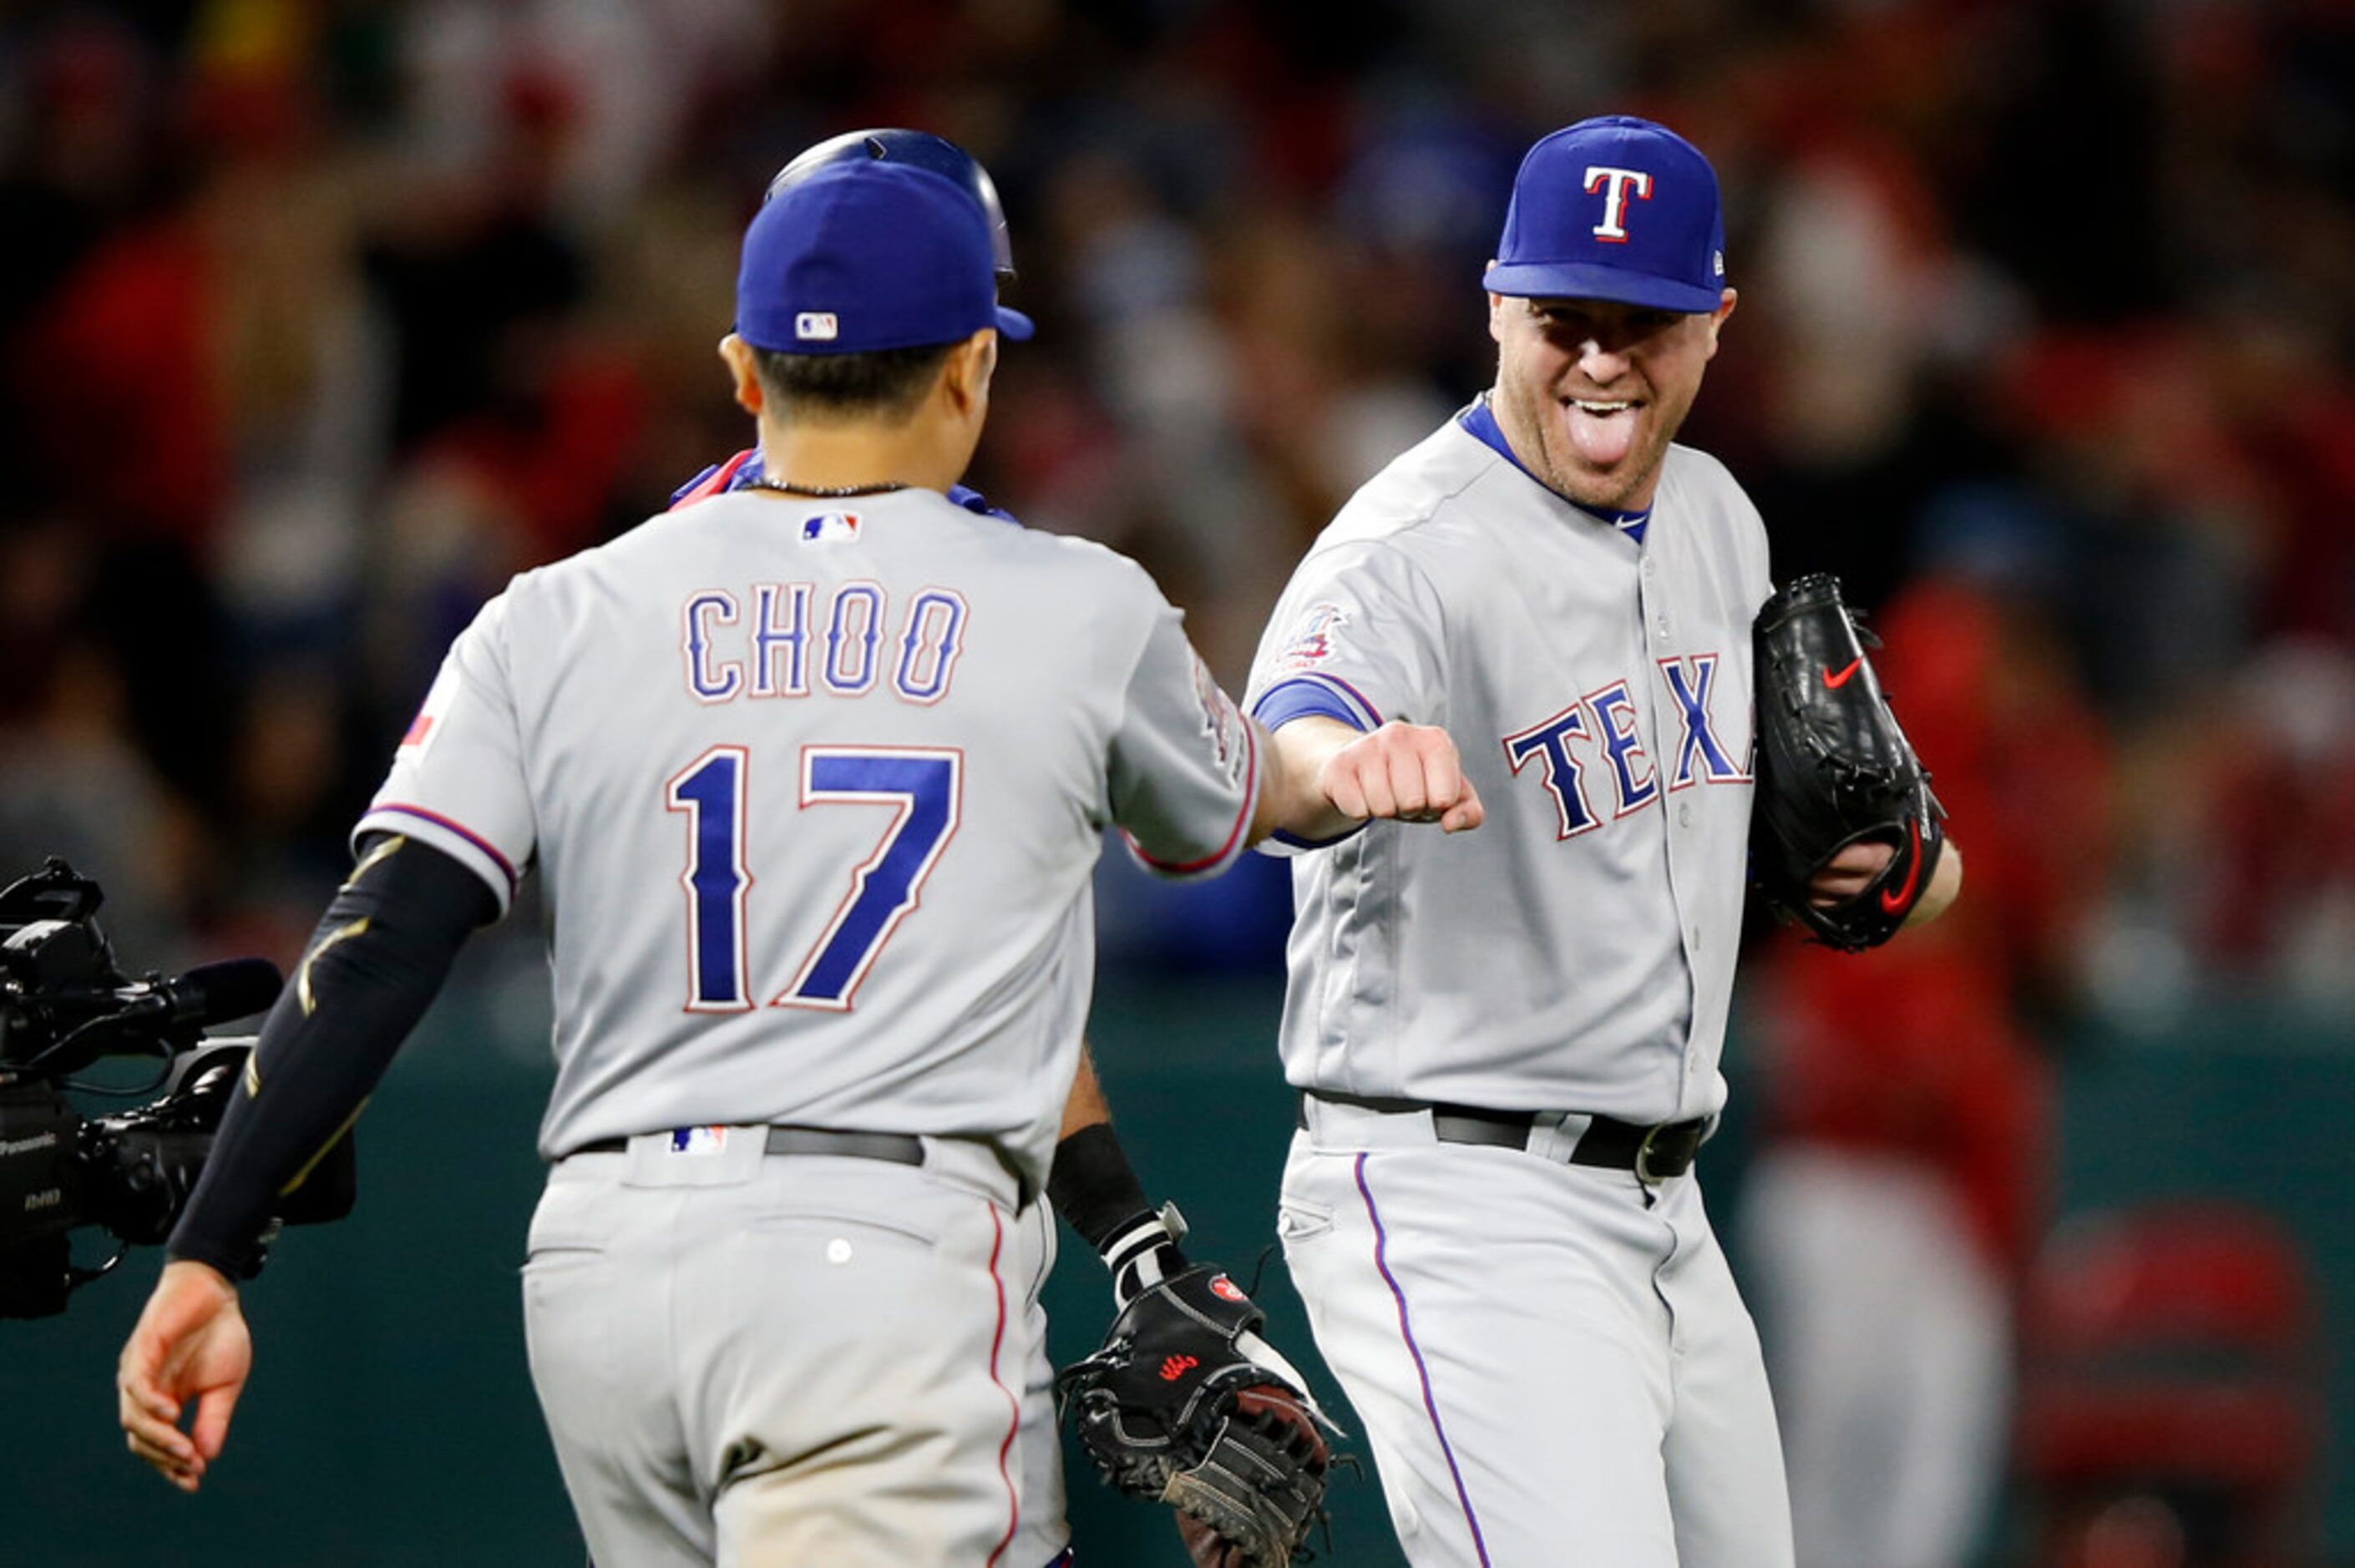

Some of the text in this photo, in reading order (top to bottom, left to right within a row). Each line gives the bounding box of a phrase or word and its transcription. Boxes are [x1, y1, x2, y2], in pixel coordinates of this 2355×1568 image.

[1583, 166, 1654, 245] T
[682, 579, 970, 706] CHOO
[1502, 652, 1755, 842] TEX
[666, 744, 965, 1014] 17
